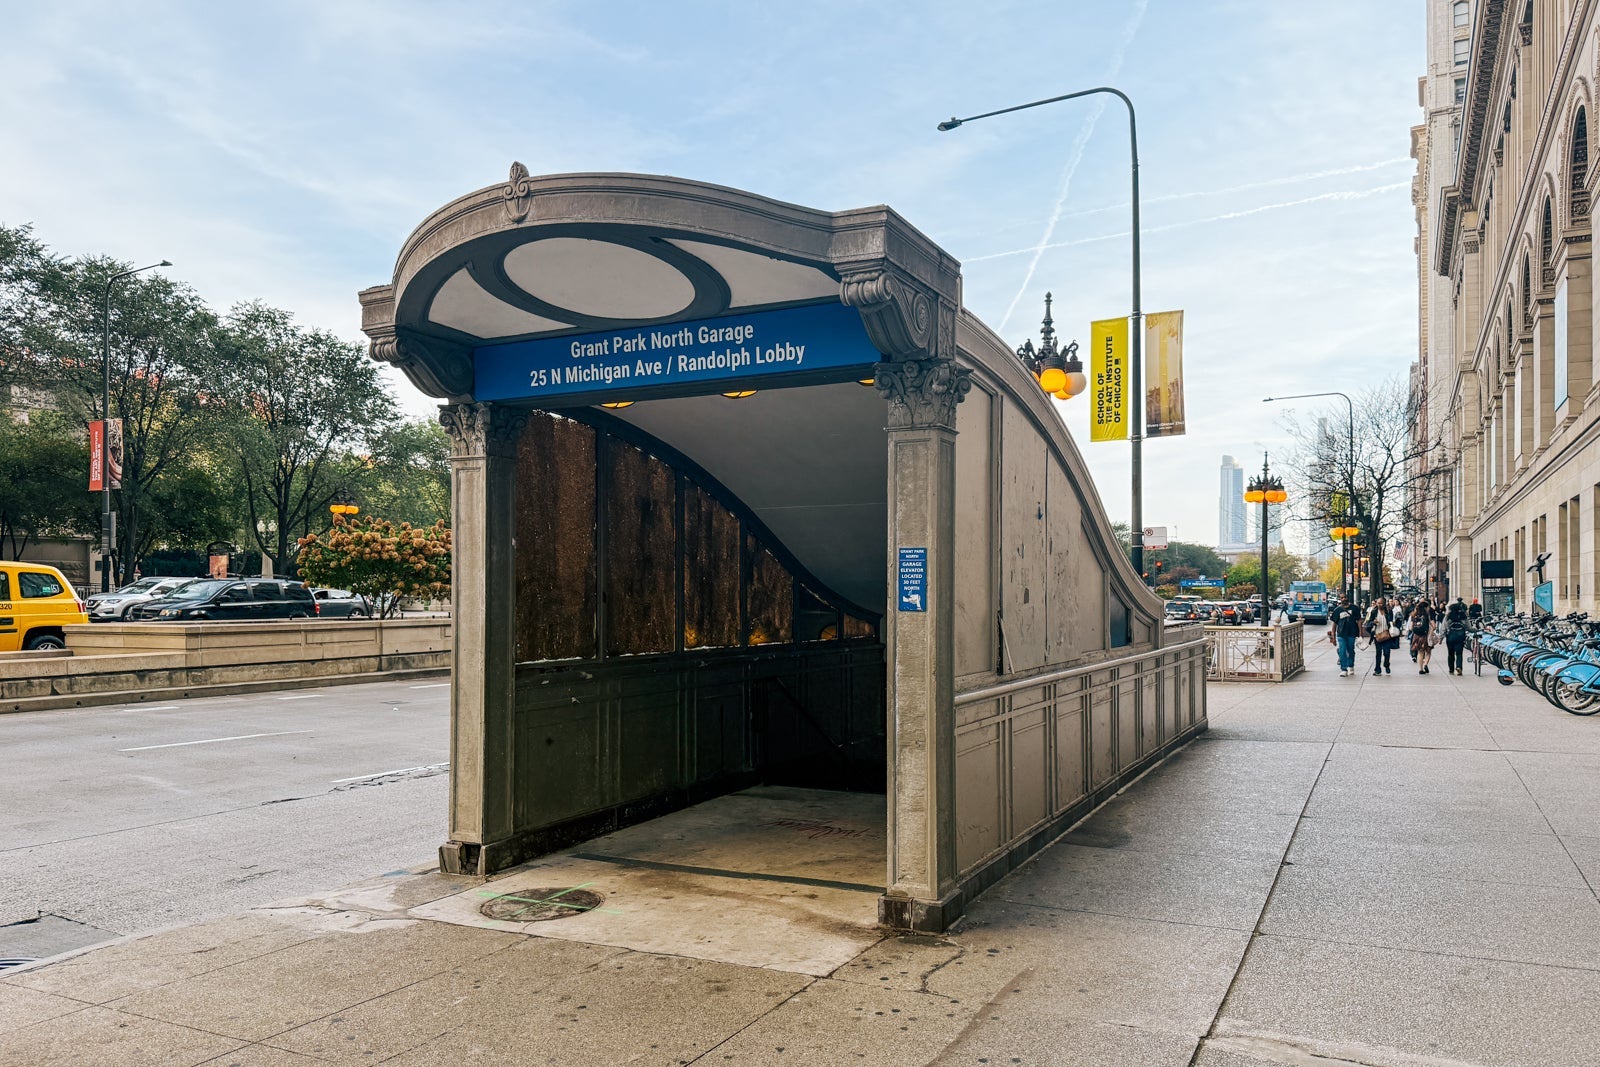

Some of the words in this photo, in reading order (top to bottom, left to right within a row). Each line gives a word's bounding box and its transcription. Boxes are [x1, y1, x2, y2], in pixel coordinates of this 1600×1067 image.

[571, 339, 609, 358] Grant
[613, 333, 647, 354] Park
[651, 328, 693, 349] North
[698, 324, 754, 344] Garage
[530, 370, 547, 387] 25
[551, 368, 561, 385] N
[565, 363, 630, 384] Michigan
[634, 359, 662, 377] Ave
[666, 356, 673, 375] /
[678, 347, 750, 373] Randolph
[756, 342, 805, 365] Lobby
[1098, 373, 1104, 385] OF
[1114, 411, 1121, 423] OF
